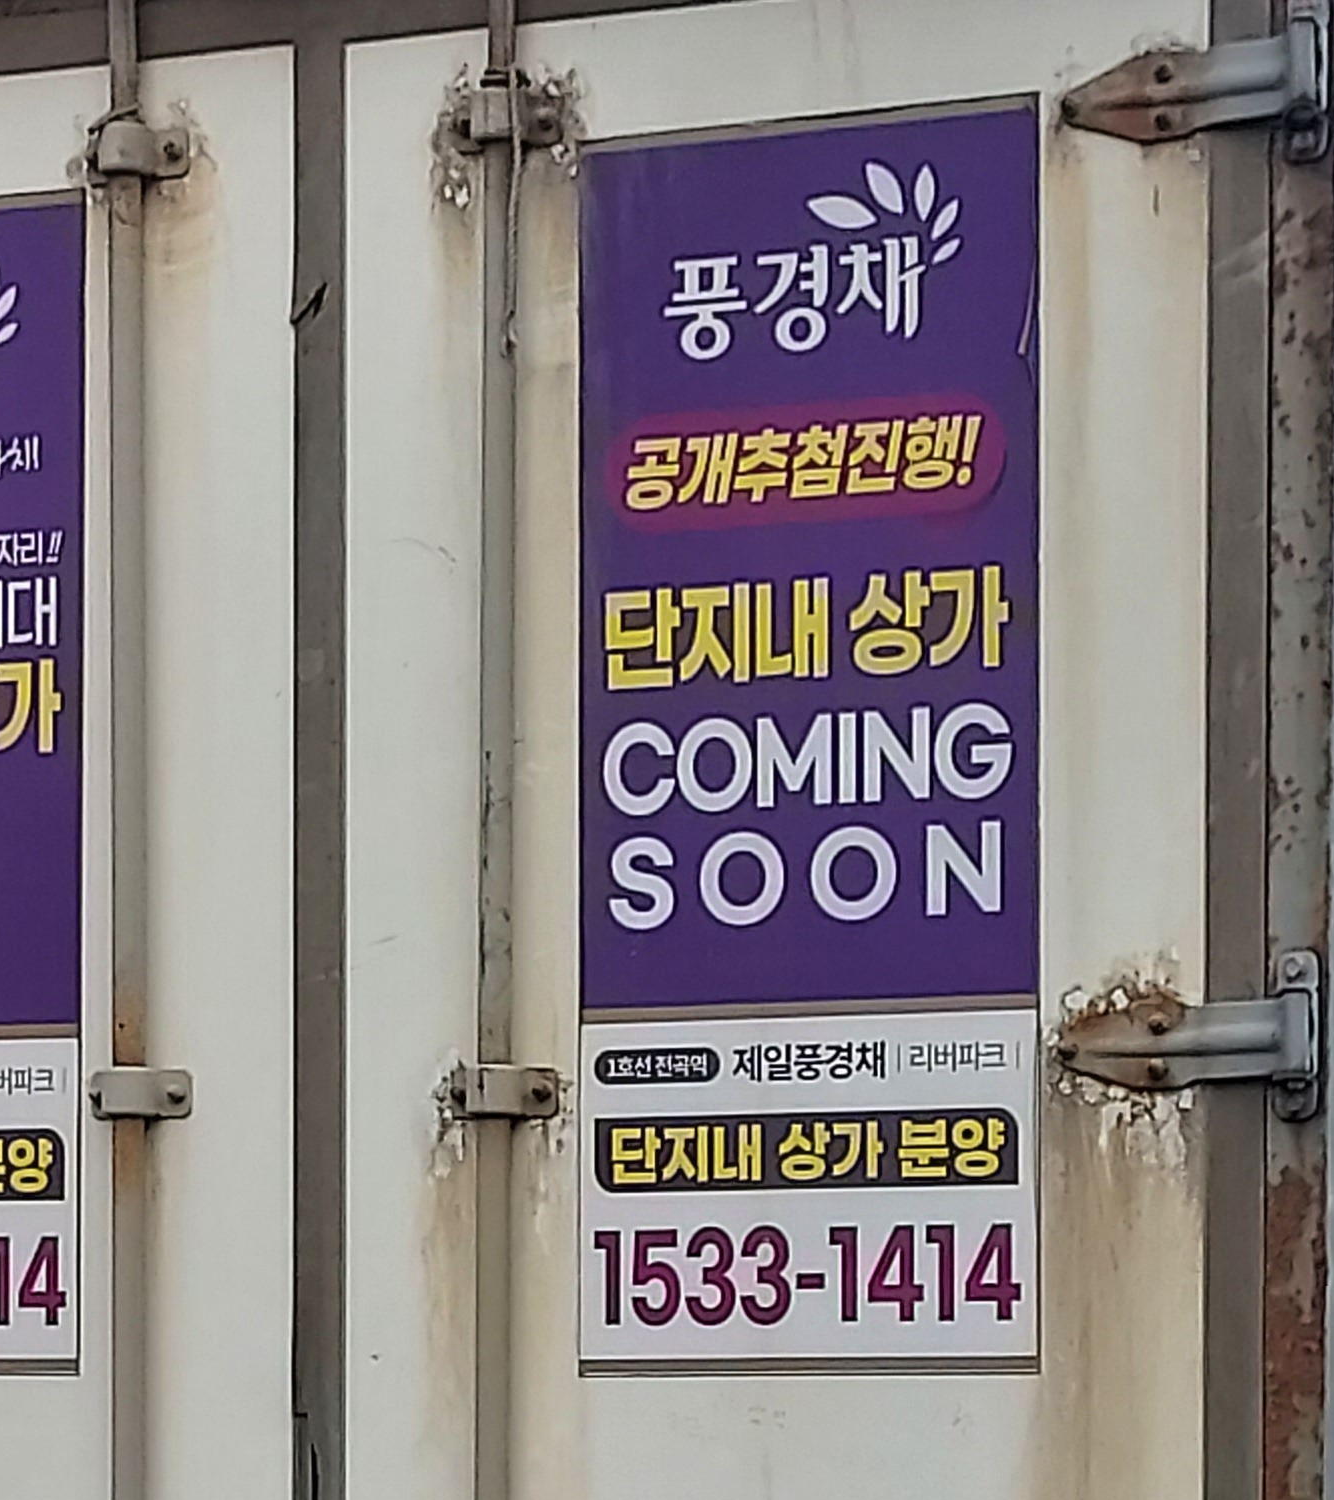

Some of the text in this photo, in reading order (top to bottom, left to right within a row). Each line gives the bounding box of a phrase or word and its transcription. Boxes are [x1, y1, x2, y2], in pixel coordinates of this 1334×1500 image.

[664, 235, 926, 360] 풍경채
[625, 415, 982, 511] 공개추첨진행!
[604, 565, 1010, 691] 단지내 상가
[603, 702, 1013, 817] COMING
[608, 819, 1002, 931] SOON
[733, 1041, 886, 1083] 제일풍경채
[908, 1042, 1007, 1074] 리버파크
[611, 1117, 1005, 1184] 단지내 상가 분양
[593, 1222, 1022, 1326] 1533-1414
